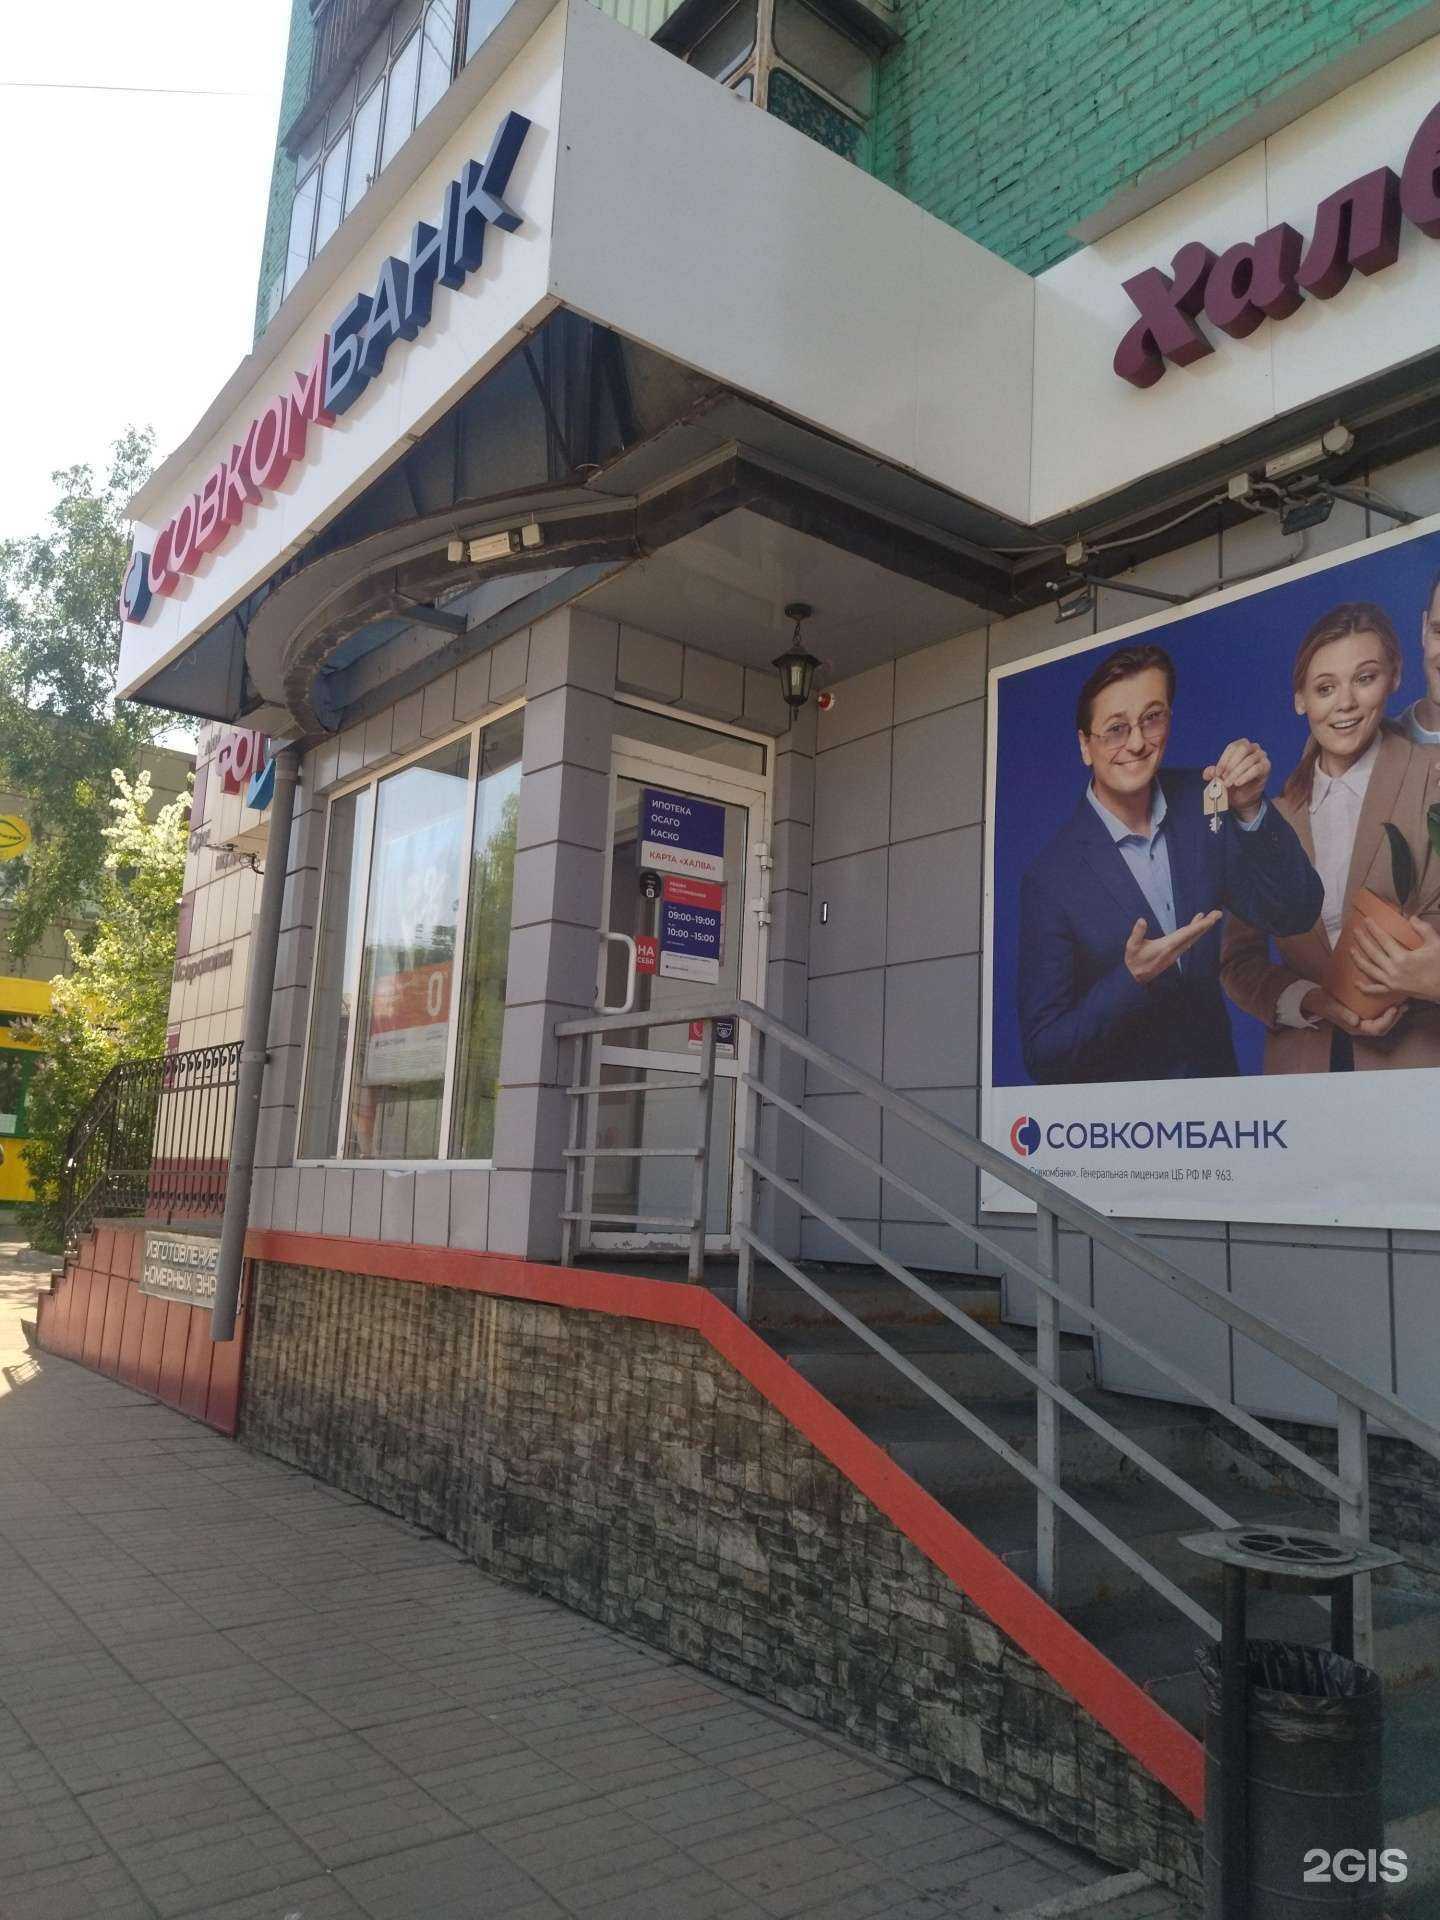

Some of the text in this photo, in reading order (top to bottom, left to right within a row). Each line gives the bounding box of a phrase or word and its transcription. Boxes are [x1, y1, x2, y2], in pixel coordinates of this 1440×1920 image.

[147, 110, 532, 598] СОВКОМБАНК
[651, 799, 692, 816] ИПОТЕКА
[651, 814, 680, 827] ОСАГО
[650, 827, 681, 841] КАСКО
[649, 850, 677, 864] КАРТА
[636, 944, 656, 957] НА
[1046, 1119, 1289, 1150] СОВКОМБАНК
[1080, 1167, 1129, 1180] Генеральная
[1130, 1169, 1170, 1182] лицензия
[1171, 1169, 1184, 1182] ЦБ
[1185, 1169, 1200, 1181] РФ
[1201, 1169, 1212, 1181] №
[146, 1240, 219, 1268] ИЗГОТОВЛЕНИЕ
[144, 1263, 193, 1292] НОМЕРНЫХ
